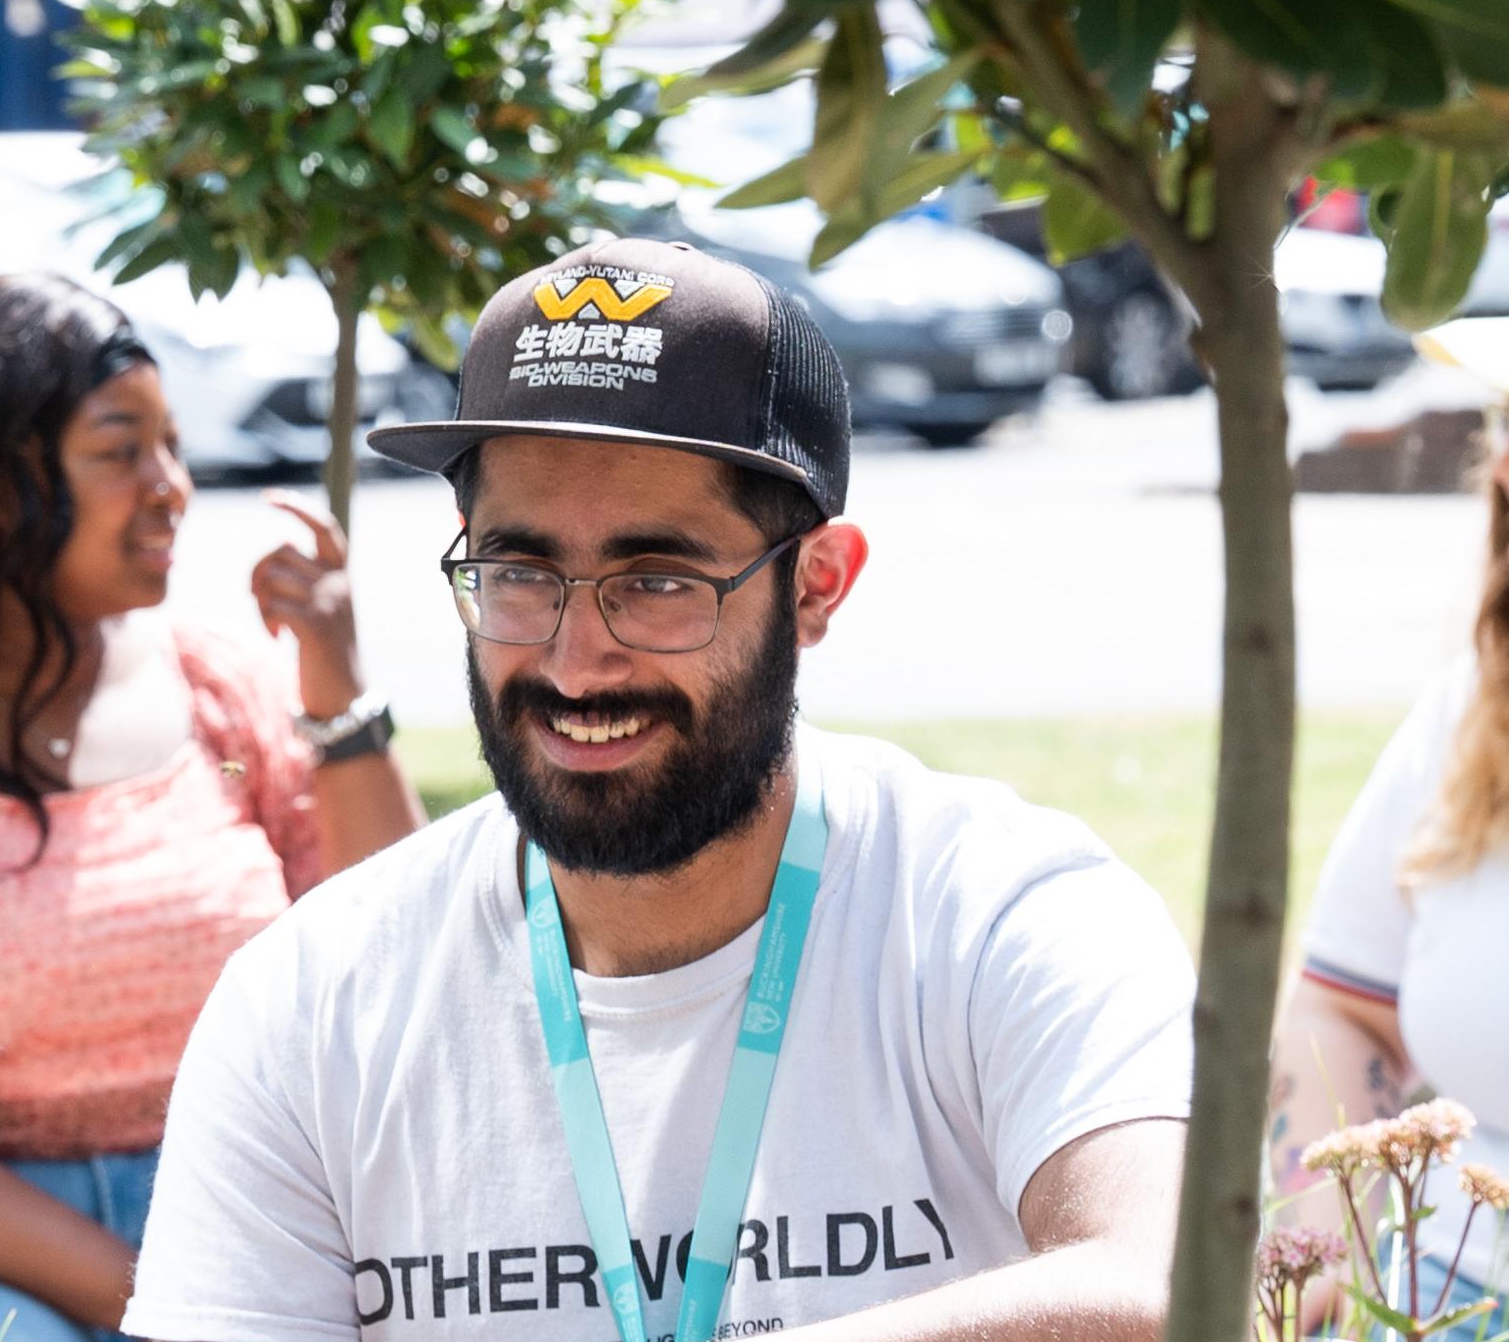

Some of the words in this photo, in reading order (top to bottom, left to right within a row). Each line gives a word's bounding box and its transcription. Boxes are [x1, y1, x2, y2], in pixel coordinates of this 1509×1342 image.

[513, 321, 663, 365] 生物武器
[509, 361, 658, 383] BIO-WEAPONS
[527, 373, 625, 391] DIVISION
